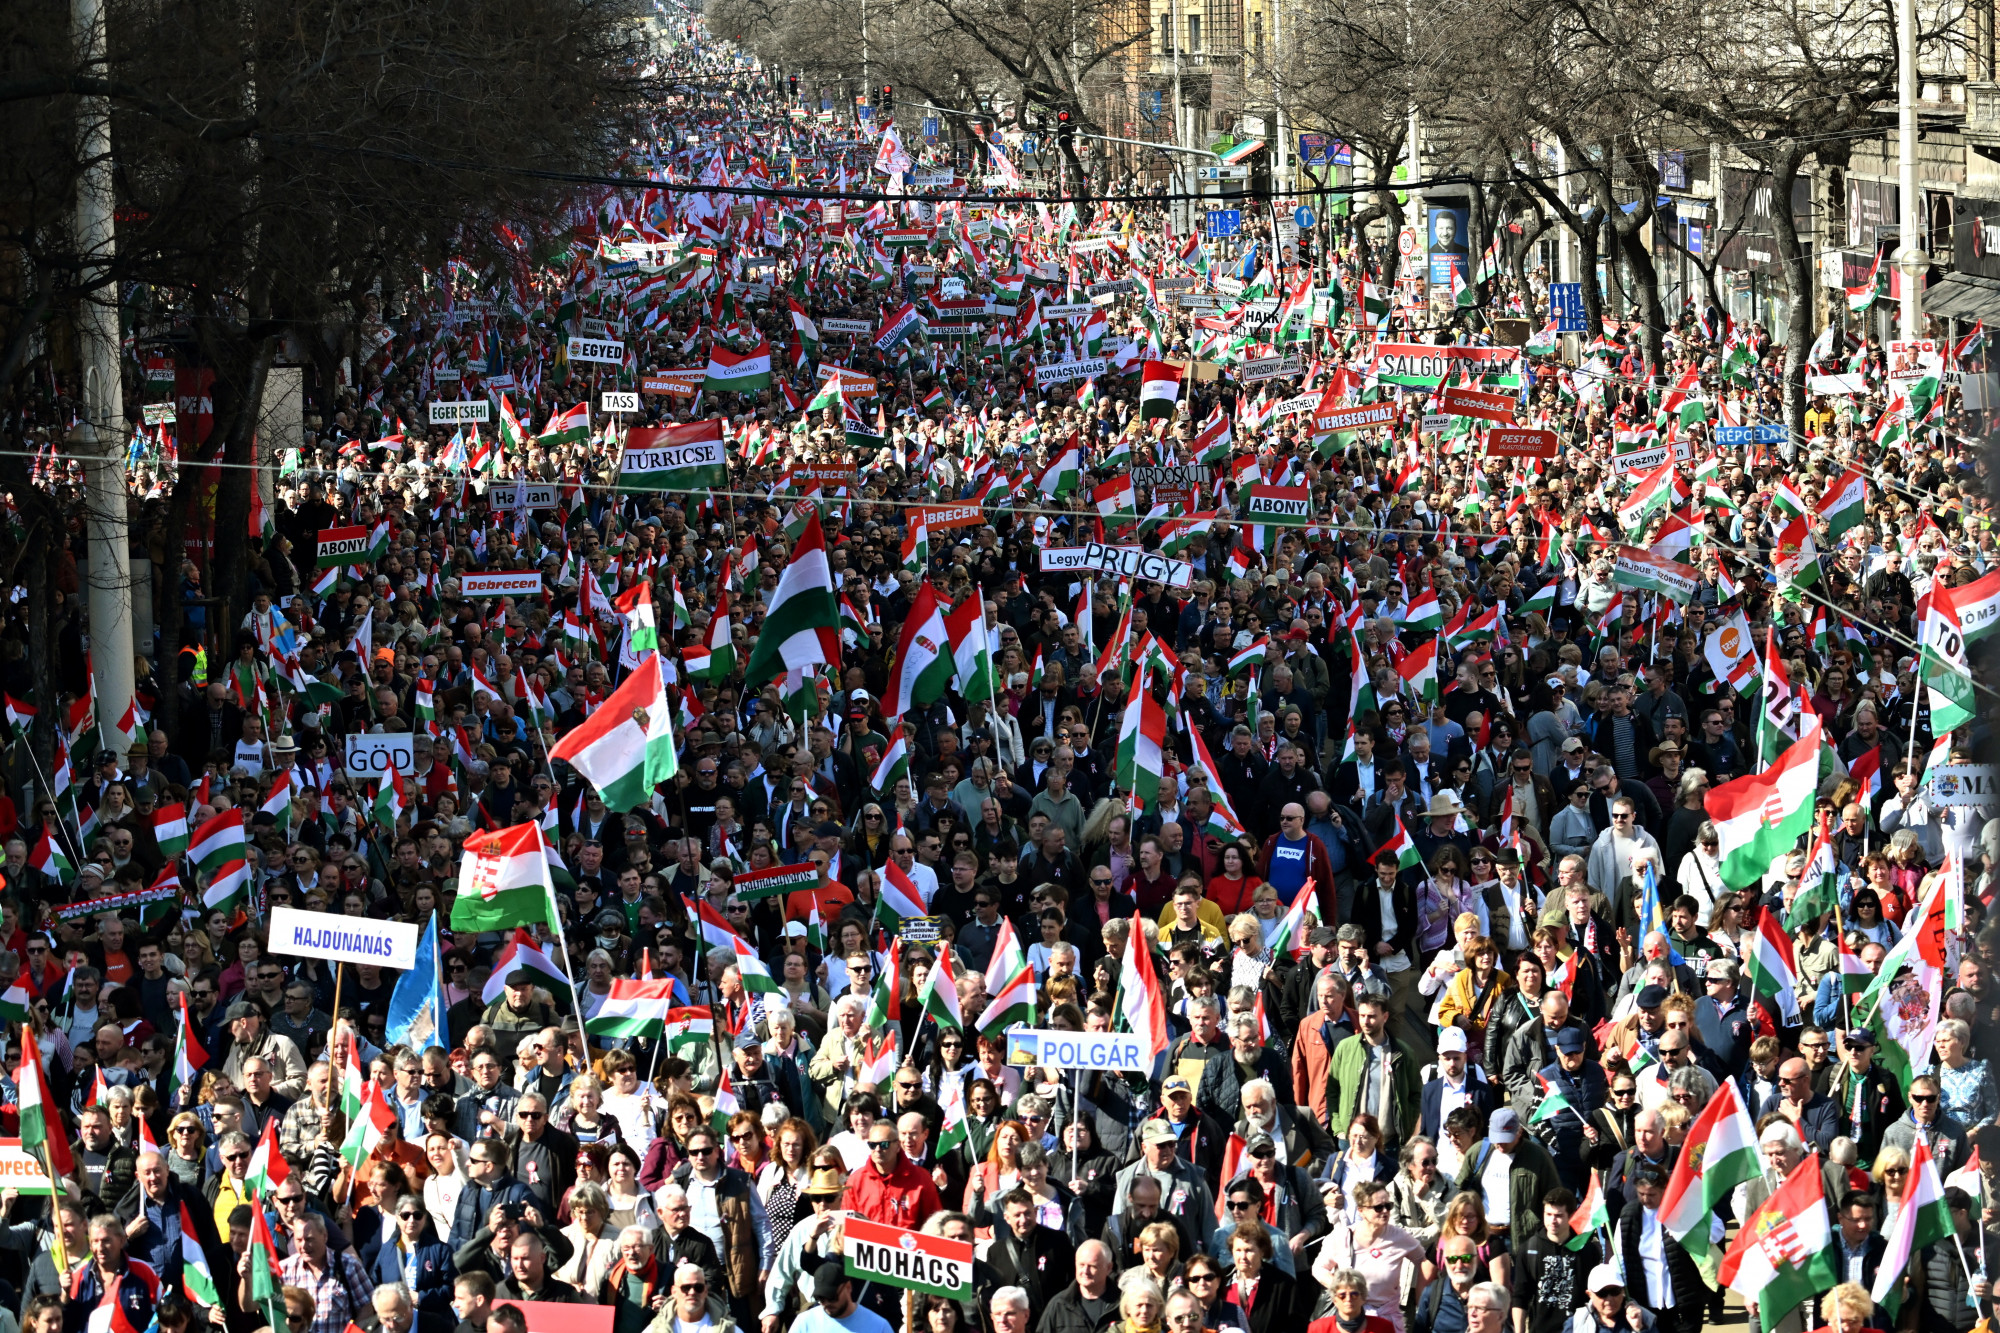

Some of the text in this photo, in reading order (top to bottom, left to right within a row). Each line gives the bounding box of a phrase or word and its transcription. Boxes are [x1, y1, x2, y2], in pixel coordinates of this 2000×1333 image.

[1402, 239, 1411, 249] 30
[950, 307, 985, 315] TISZADADA
[1245, 310, 1304, 326] HARKNY
[827, 320, 867, 331] Taktakenéz
[937, 326, 971, 335] TISZADADA
[582, 343, 623, 359] EGYED
[1038, 360, 1105, 380] KOVÁCSVÁGÁS
[1383, 350, 1514, 379] SALGÓTARJÁN
[644, 381, 692, 393] DEBRECEN
[605, 395, 634, 408] TASS
[1277, 397, 1316, 413] KESZTHELY
[432, 404, 487, 419] EGERCSEHI
[1317, 405, 1395, 430] VERESEGYHÁZ
[1500, 434, 1543, 445] PEST 06.
[625, 445, 716, 471] TÚRRICSE
[495, 490, 550, 505] Havan
[1252, 498, 1306, 515] ABONY
[319, 539, 365, 556] ABONY
[1083, 542, 1183, 584] PRÜGY
[467, 578, 537, 591] Debrecen
[237, 752, 260, 761] PUMA
[349, 744, 411, 772] GÖD
[293, 925, 393, 958] HAJDÚNÁNÁS
[1042, 1037, 1140, 1069] POLGÁR
[856, 1240, 961, 1289] MOHÁCS
